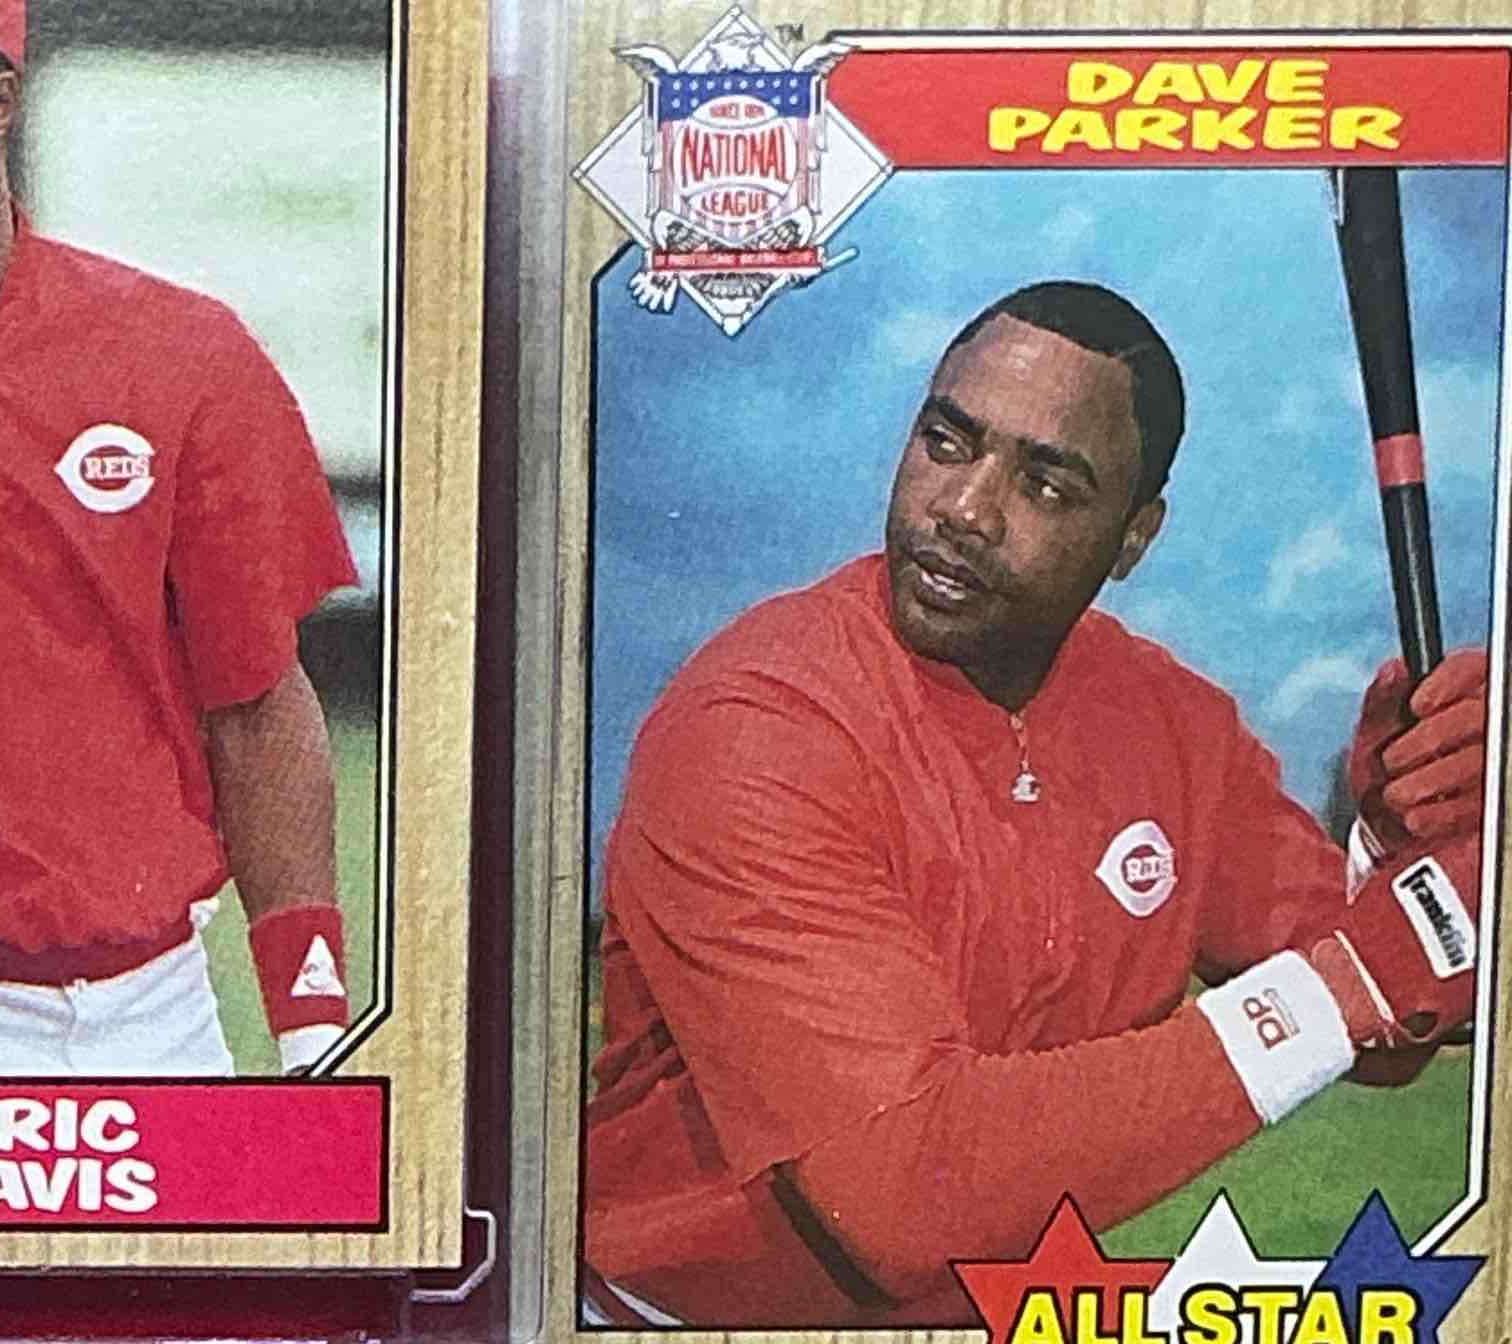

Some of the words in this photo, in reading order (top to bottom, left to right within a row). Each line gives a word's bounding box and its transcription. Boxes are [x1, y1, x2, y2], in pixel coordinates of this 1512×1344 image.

[1067, 59, 1330, 105] DAVE
[988, 105, 1403, 153] PARKER
[681, 124, 793, 188] NATIONAL
[700, 190, 769, 218] LEAGUE
[84, 454, 151, 481] REDS
[1398, 864, 1468, 967] Franklin
